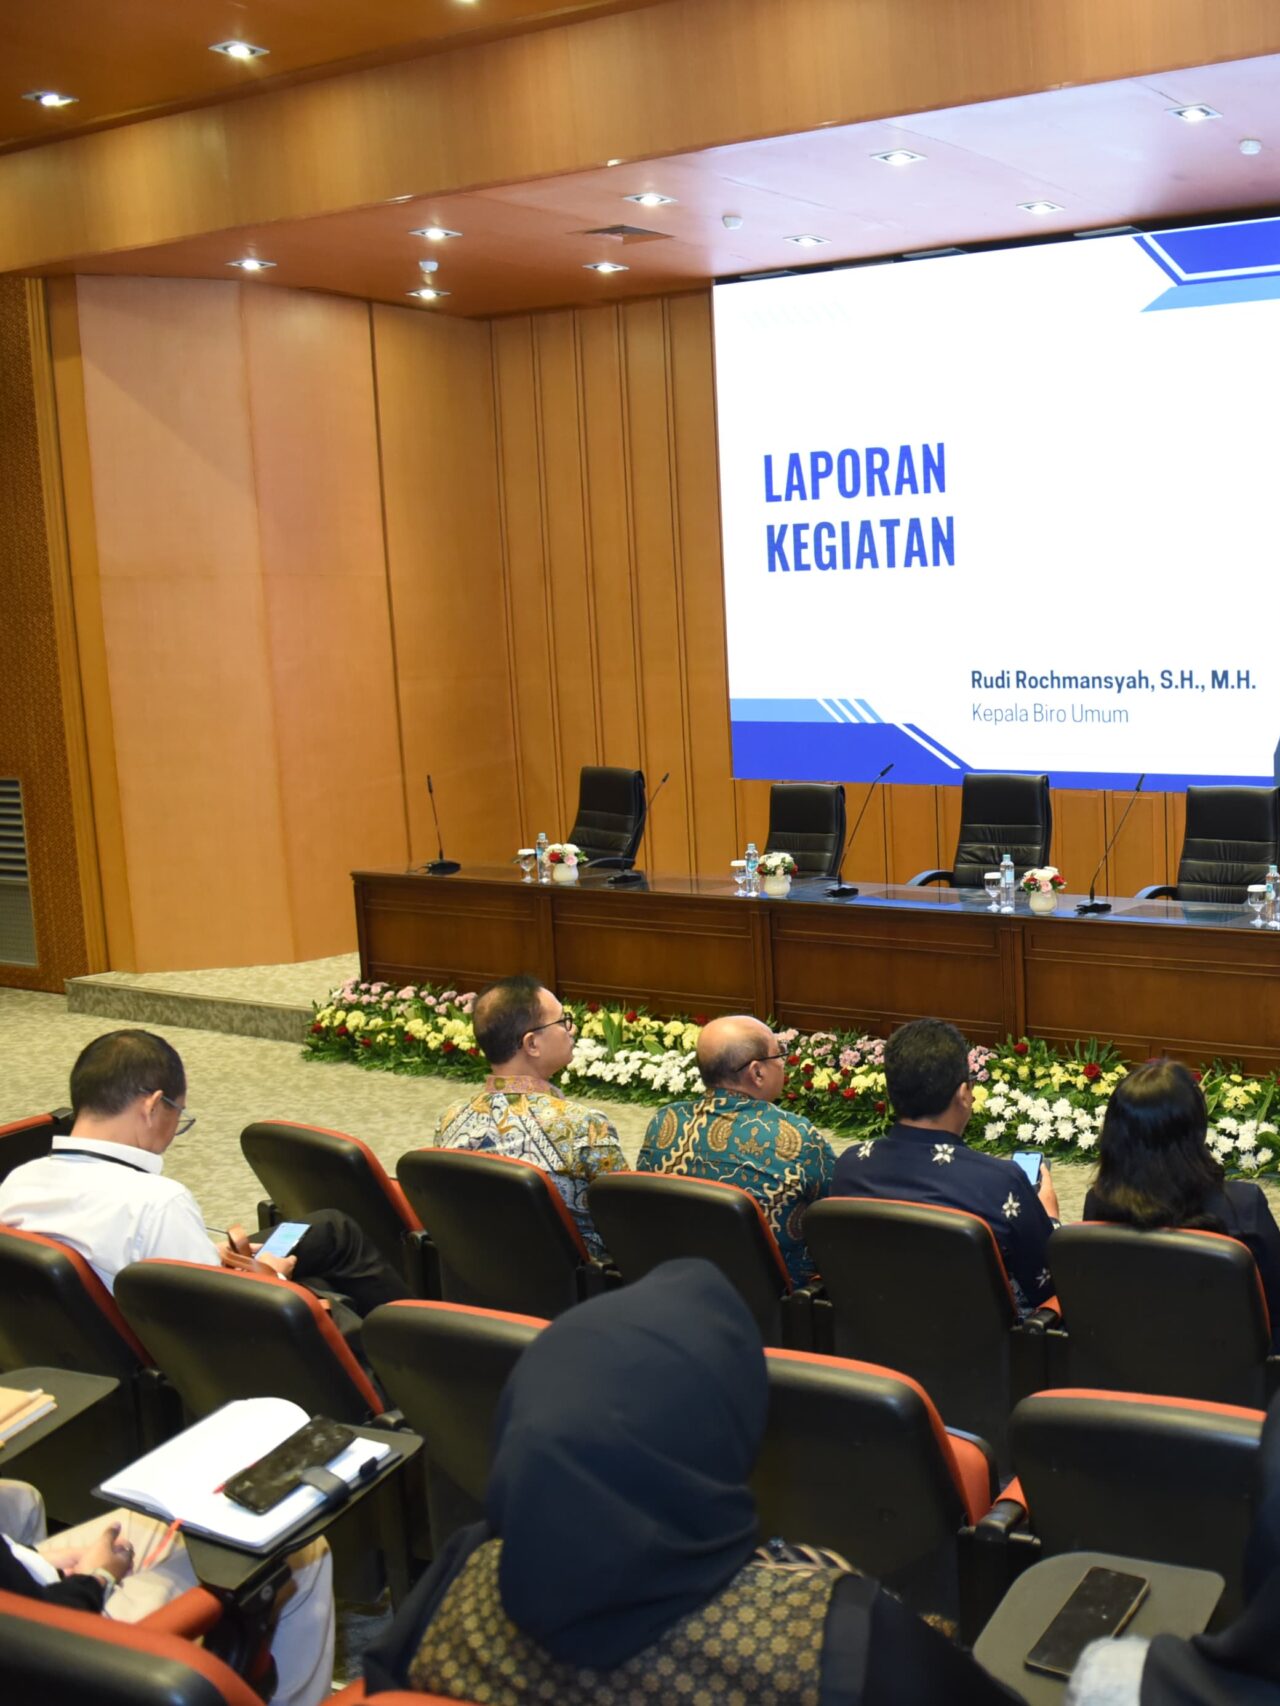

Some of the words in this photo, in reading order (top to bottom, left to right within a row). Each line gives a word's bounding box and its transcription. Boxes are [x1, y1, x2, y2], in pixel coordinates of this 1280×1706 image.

[763, 442, 946, 503] LAPORAN
[766, 516, 955, 572] KEGIATAN
[971, 669, 1011, 690] Rudi
[1015, 669, 1156, 694] Rochmansyah,
[1160, 669, 1206, 692] S.H.,
[1211, 669, 1257, 690] M.H.
[972, 703, 1029, 726] Kepala
[1033, 703, 1067, 723] Biro
[1071, 703, 1129, 724] Umum
